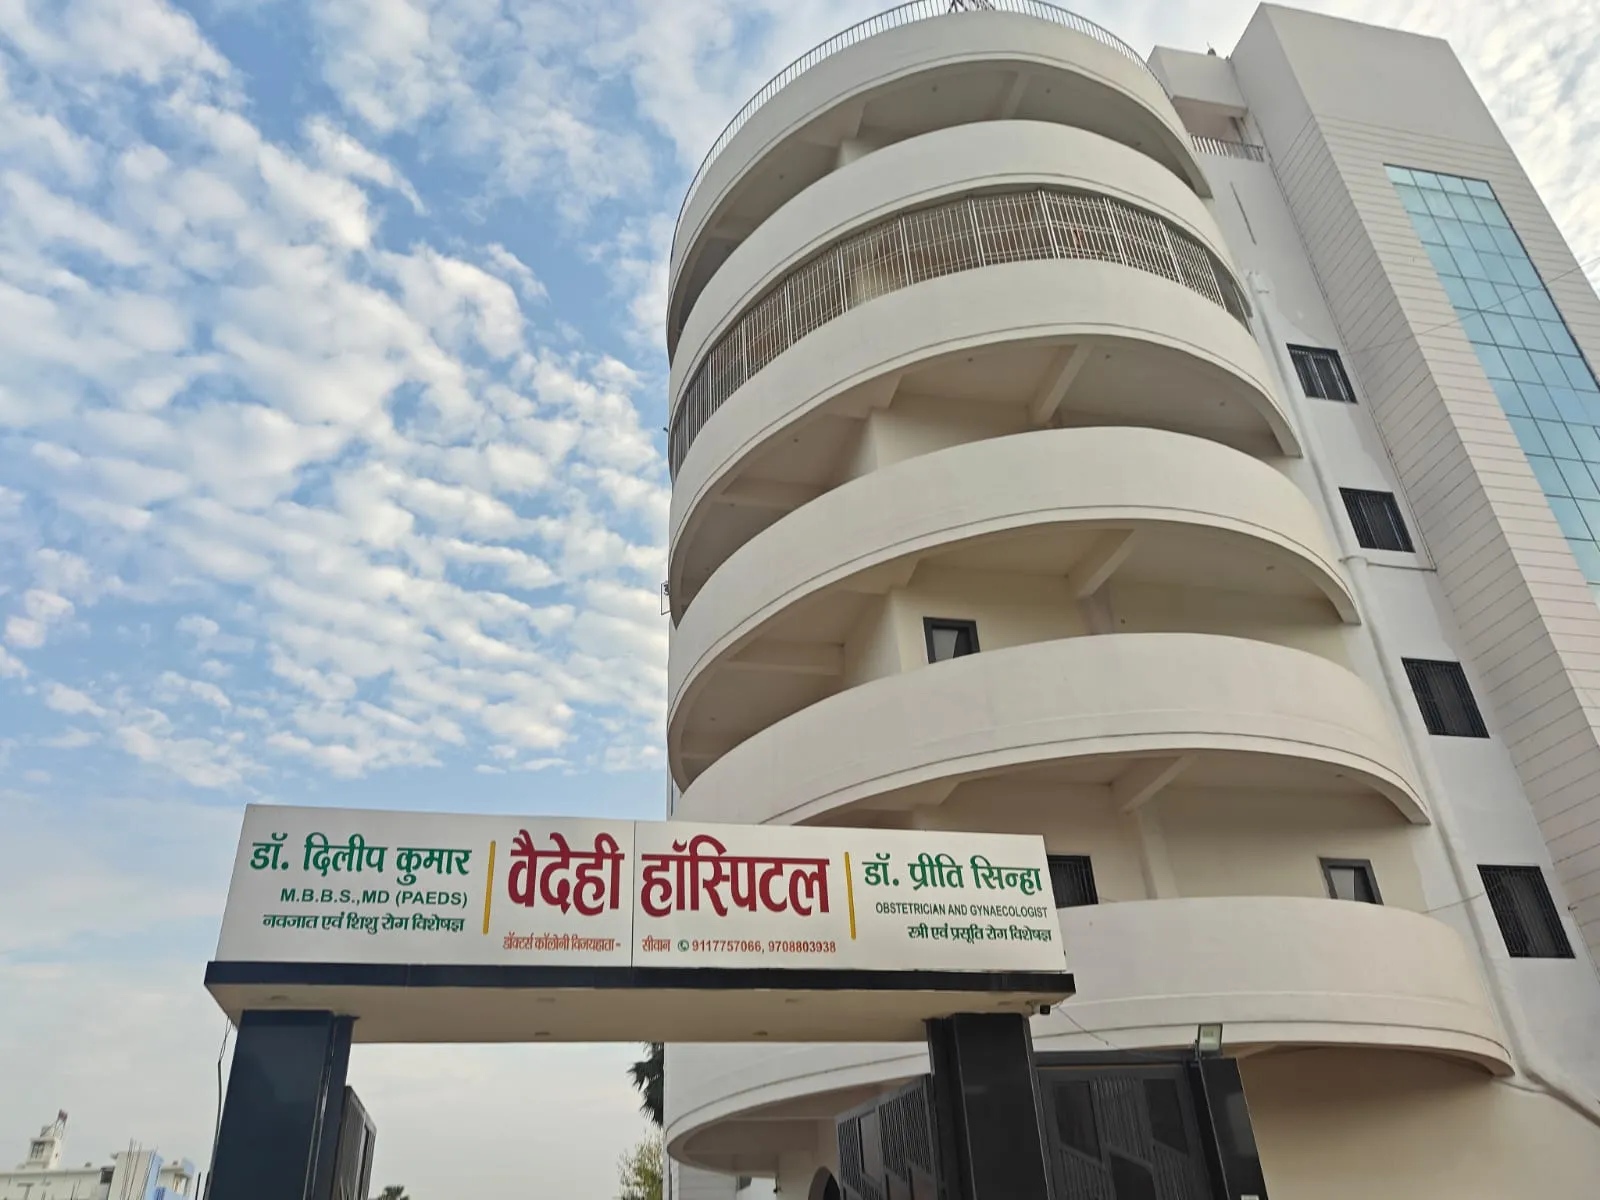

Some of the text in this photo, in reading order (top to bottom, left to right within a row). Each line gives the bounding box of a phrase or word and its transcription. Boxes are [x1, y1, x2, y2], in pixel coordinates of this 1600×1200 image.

[250, 832, 472, 885] डॉ. दिलीप कुमार
[508, 829, 830, 917] वैदेही हॉस्पिटल
[862, 853, 1042, 896] डॉ. प्रीति सिन्हा
[395, 891, 468, 908] (PAEDS)
[875, 902, 1048, 918] OBSTETRICIAN AND GYNAECOLOGIST
[262, 912, 465, 934] नवजात एवं शिशु रोग विशेषज्ञ
[931, 922, 949, 940] एवं
[986, 925, 1008, 940] रोग
[641, 935, 671, 952] सीवान
[692, 939, 765, 954] 9117757066,
[768, 941, 836, 953] 9708803938
